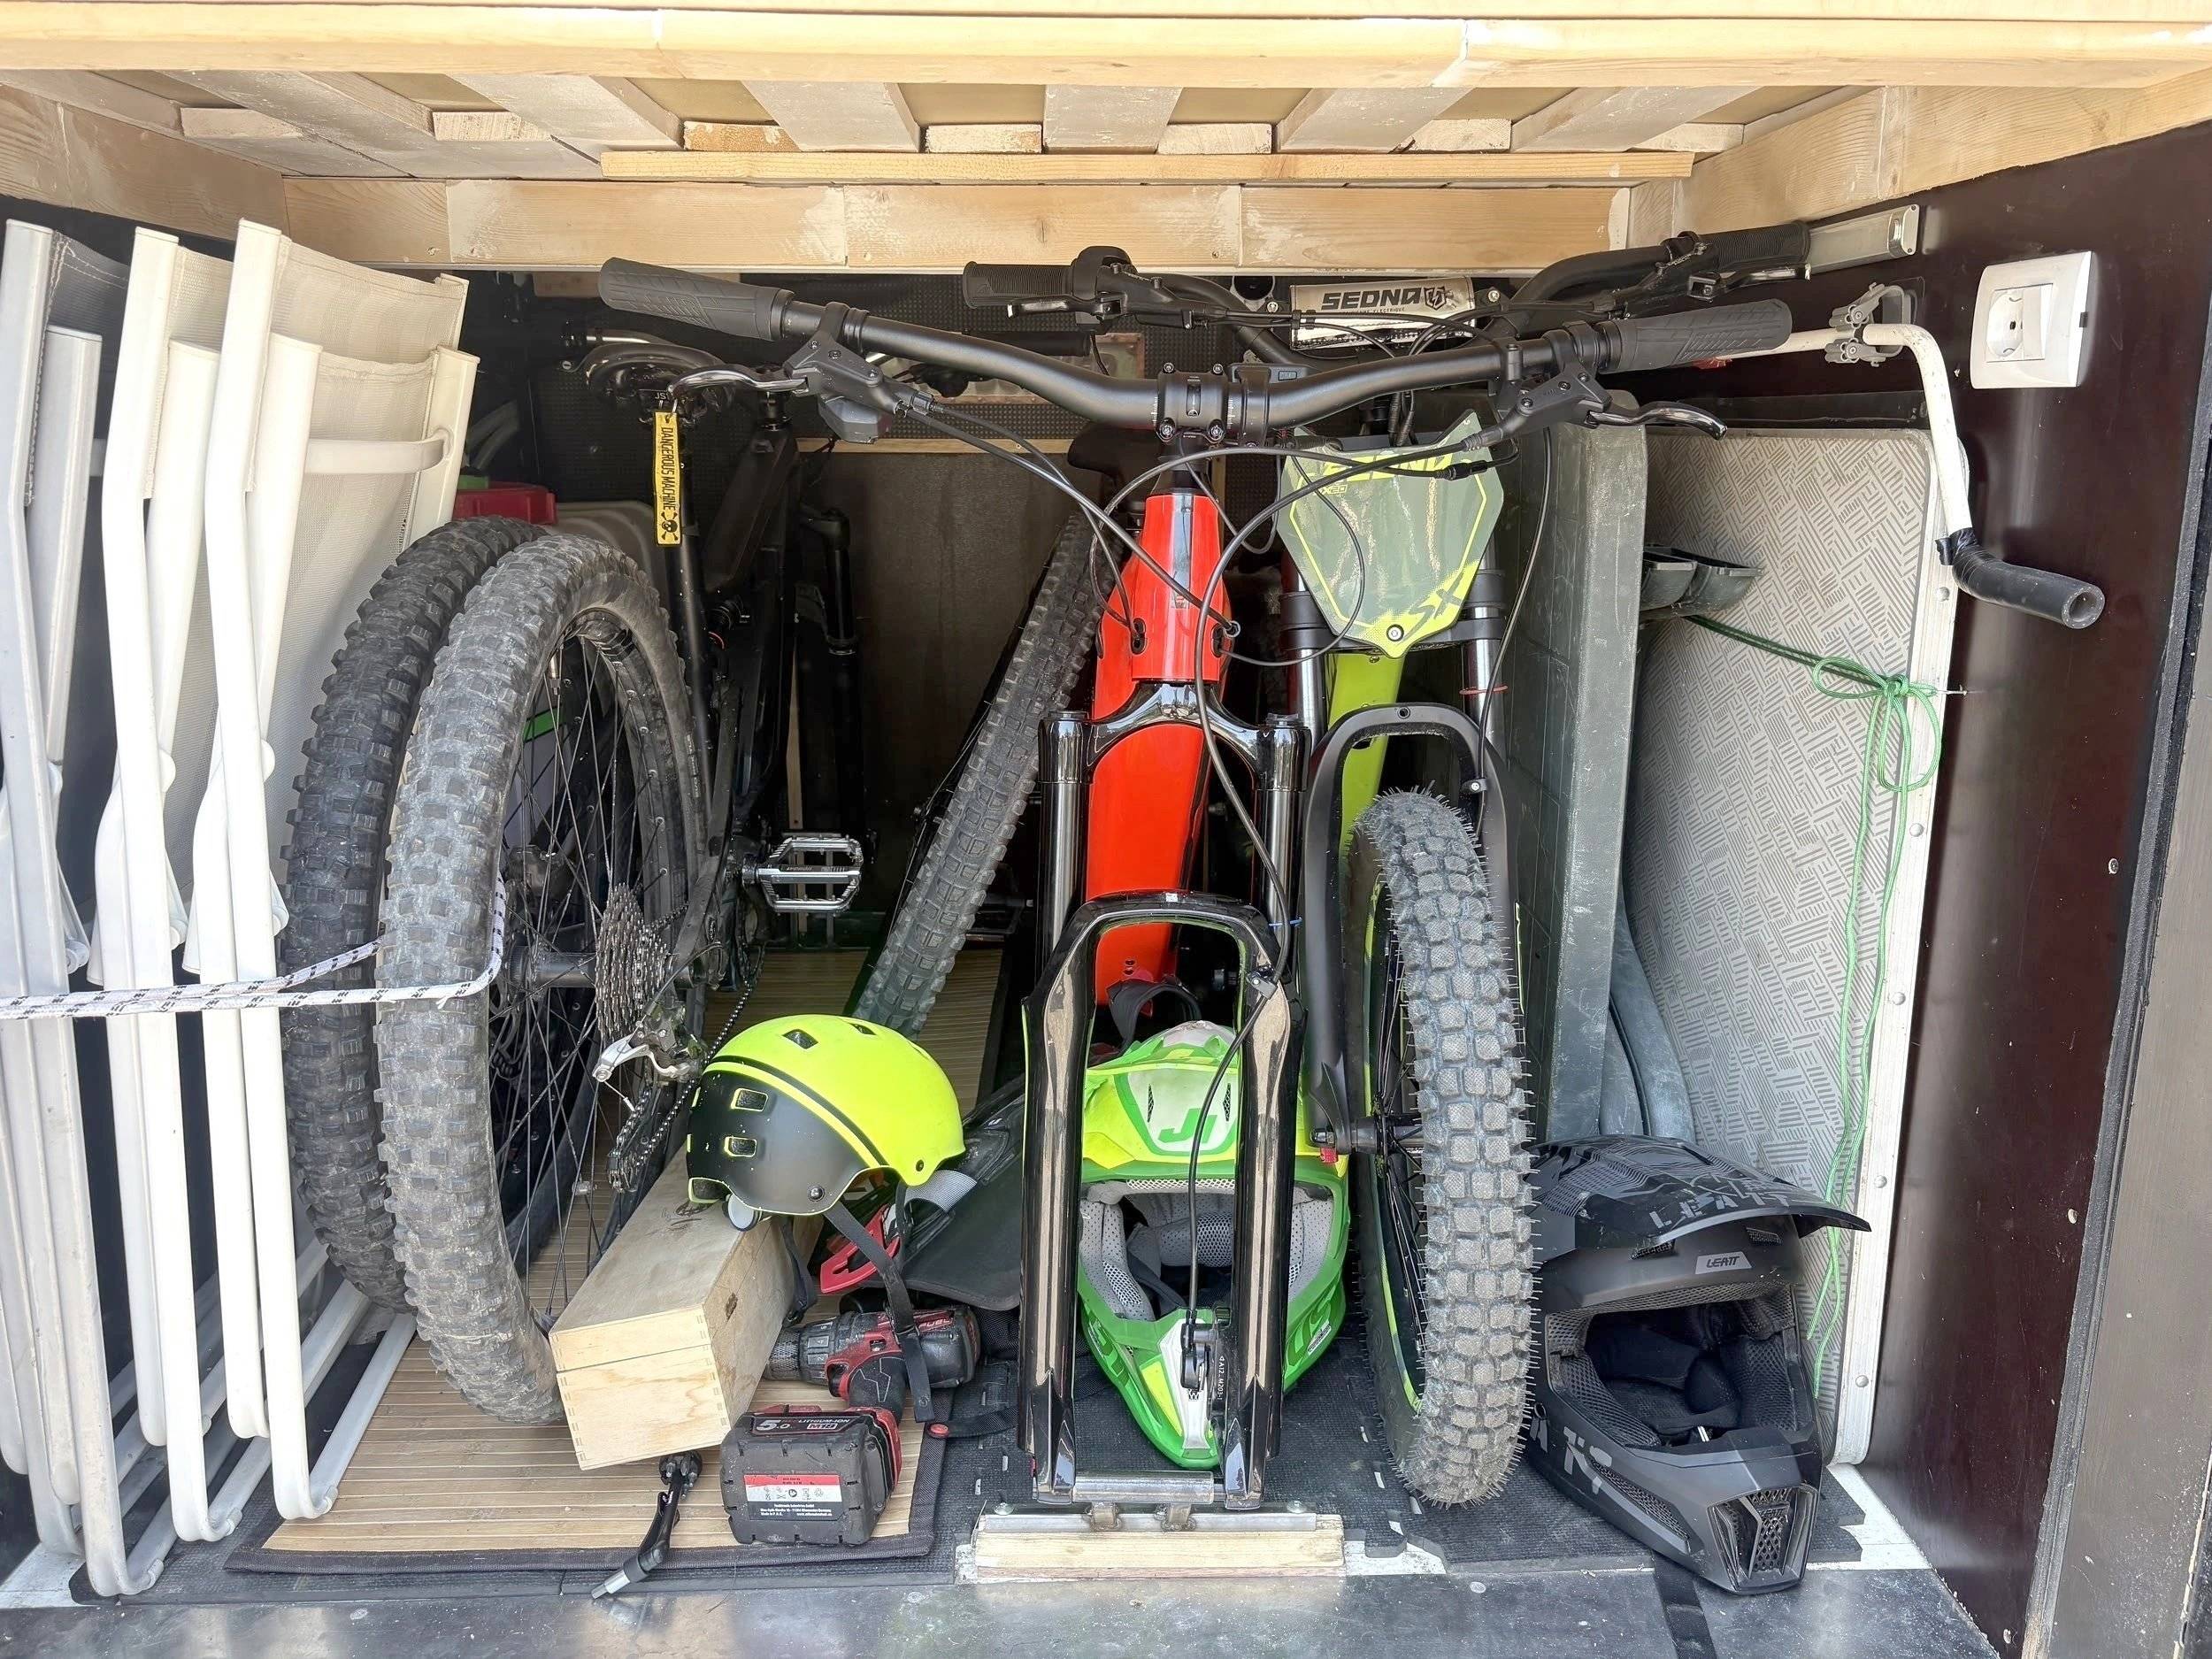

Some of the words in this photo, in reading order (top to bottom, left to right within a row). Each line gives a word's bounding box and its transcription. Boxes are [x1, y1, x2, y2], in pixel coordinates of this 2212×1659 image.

[660, 427, 674, 474] DANGEROUS
[661, 476, 676, 511] MACHINE
[1706, 1256, 1740, 1268] LEATT
[918, 1319, 949, 1328] FUEL
